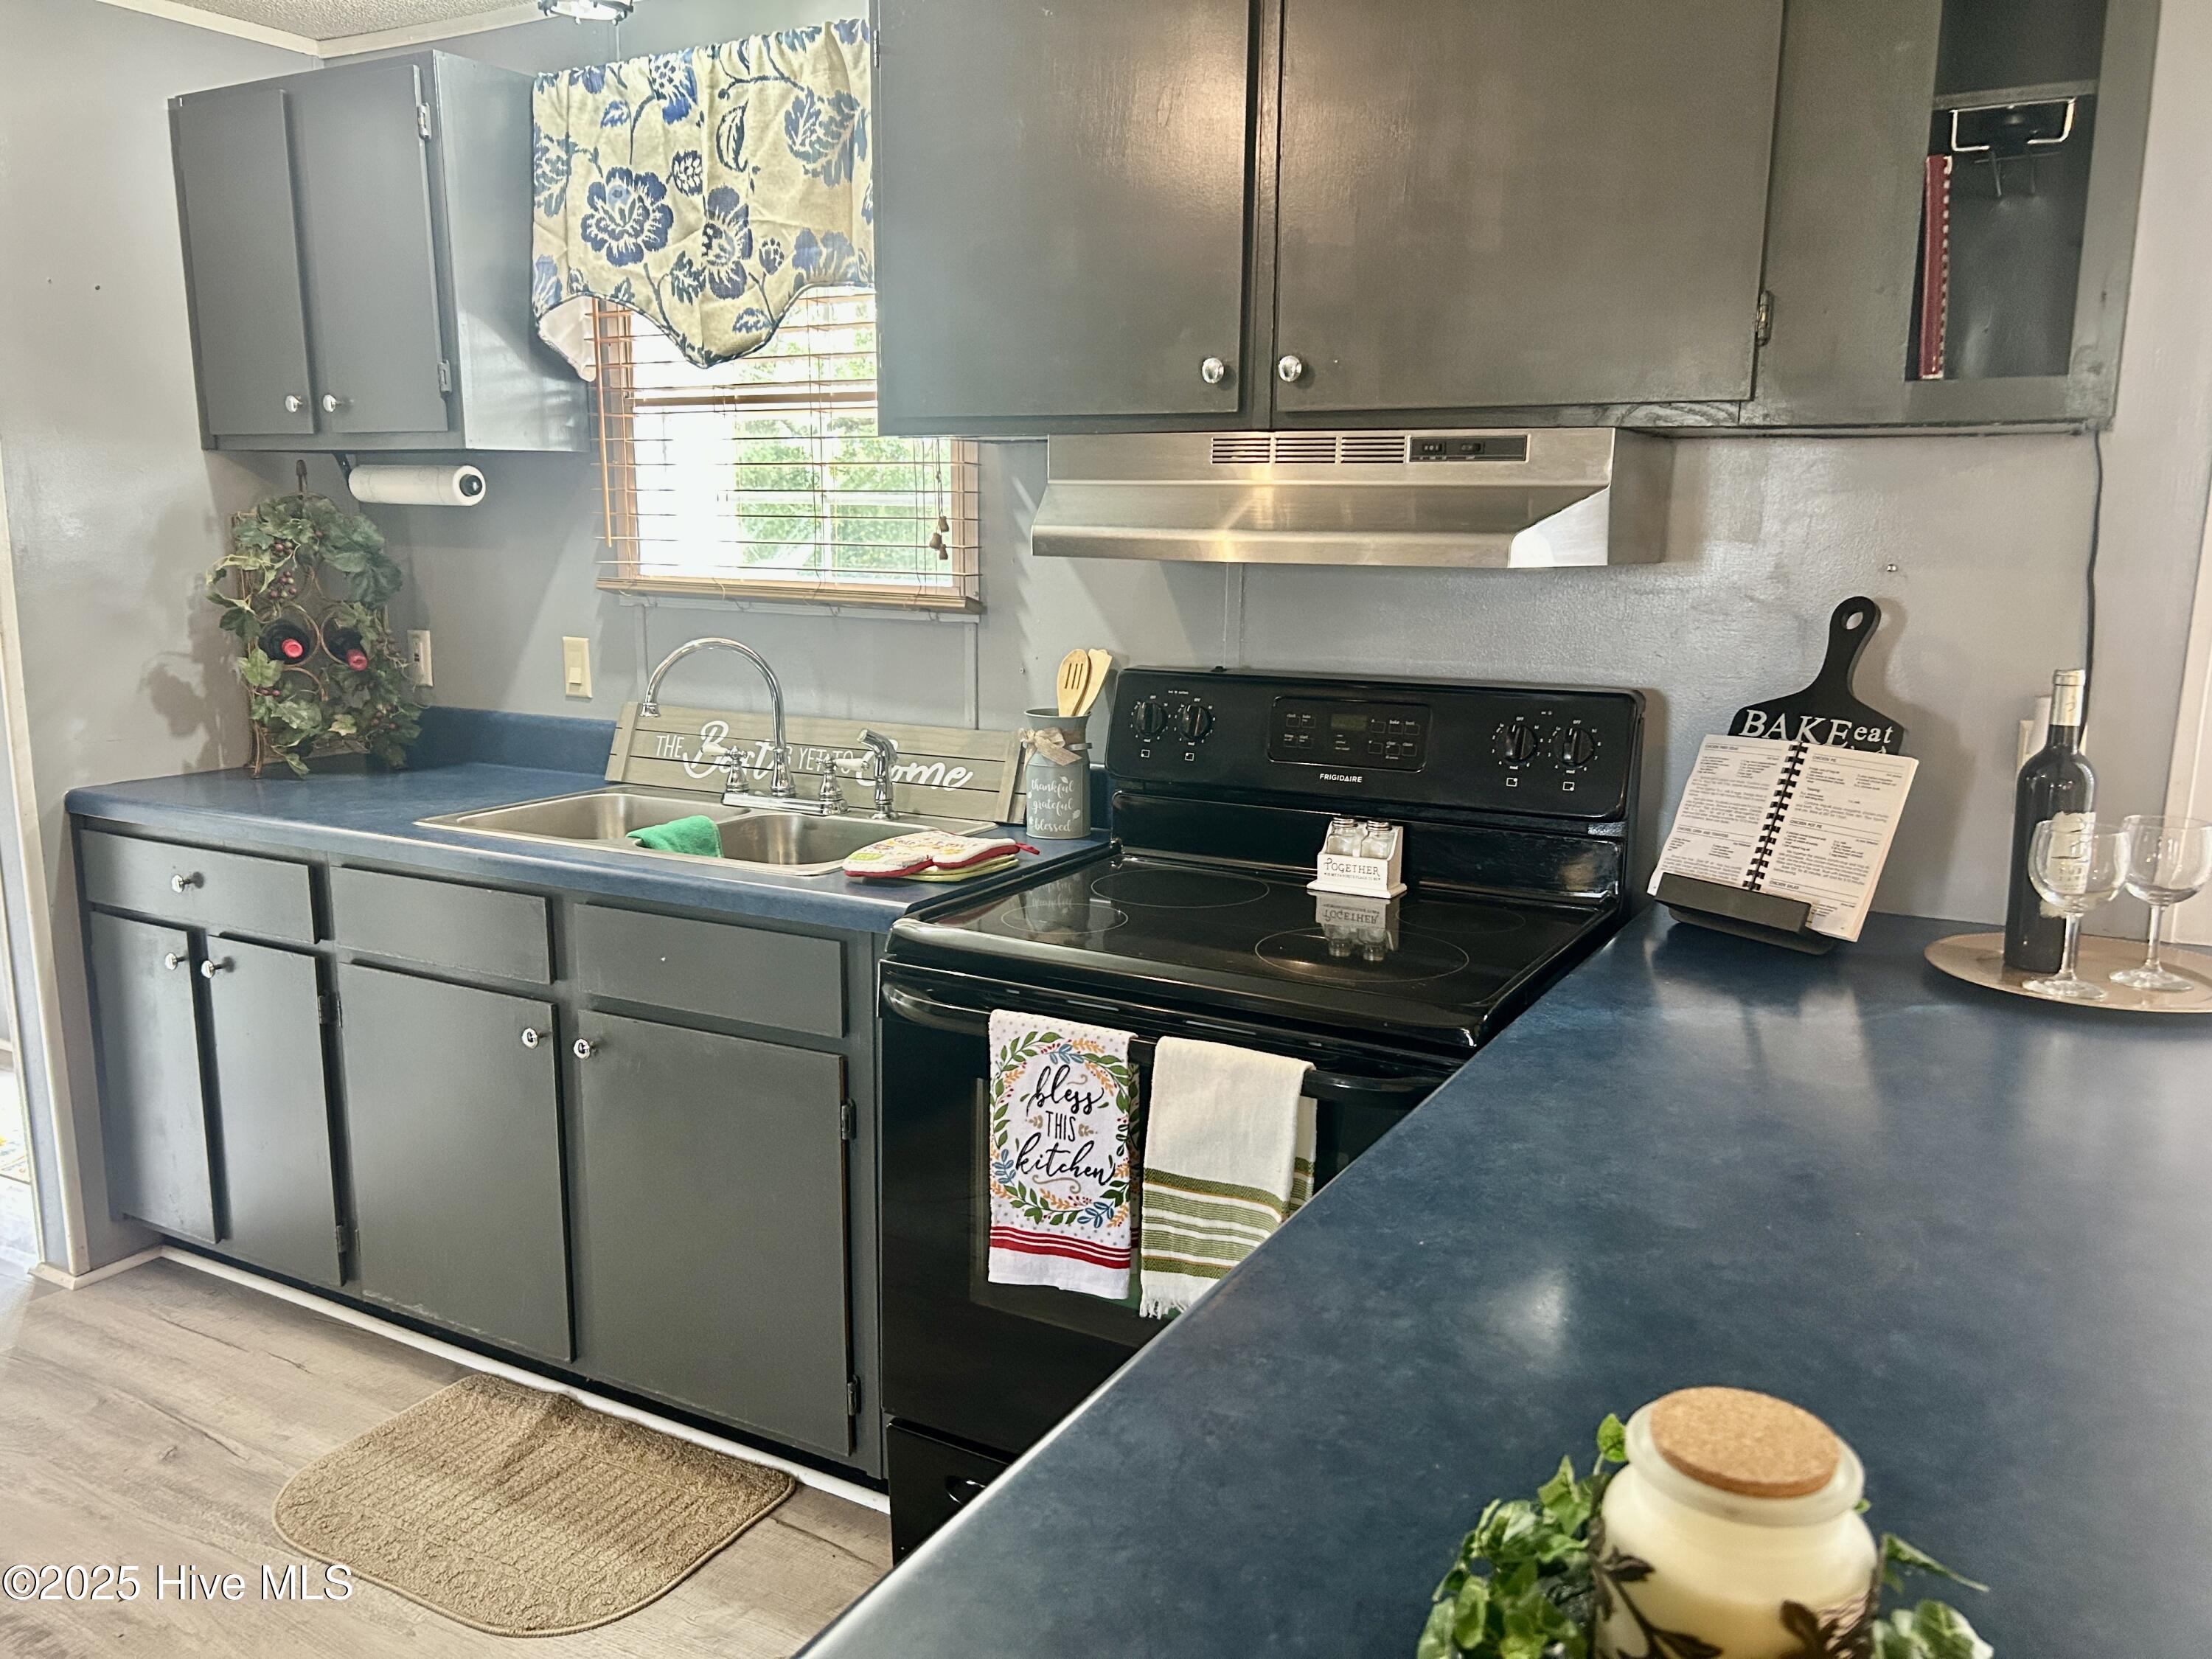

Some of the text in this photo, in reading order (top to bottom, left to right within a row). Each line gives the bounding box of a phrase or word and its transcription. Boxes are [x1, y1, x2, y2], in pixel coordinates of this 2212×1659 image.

[1739, 709, 1853, 748] BAKE
[1854, 726, 1893, 743] eat
[656, 735, 684, 758] THE
[799, 747, 827, 771] YET
[1320, 773, 1363, 782] FRIGIDAIRE
[1032, 778, 1074, 799] thankful
[1032, 798, 1074, 816] grateful
[1033, 818, 1071, 832] blessed
[1324, 858, 1380, 877] TOGETHER
[1026, 1065, 1105, 1116] bless
[1046, 1110, 1076, 1141] THIS
[1015, 1132, 1116, 1186] kitchen
